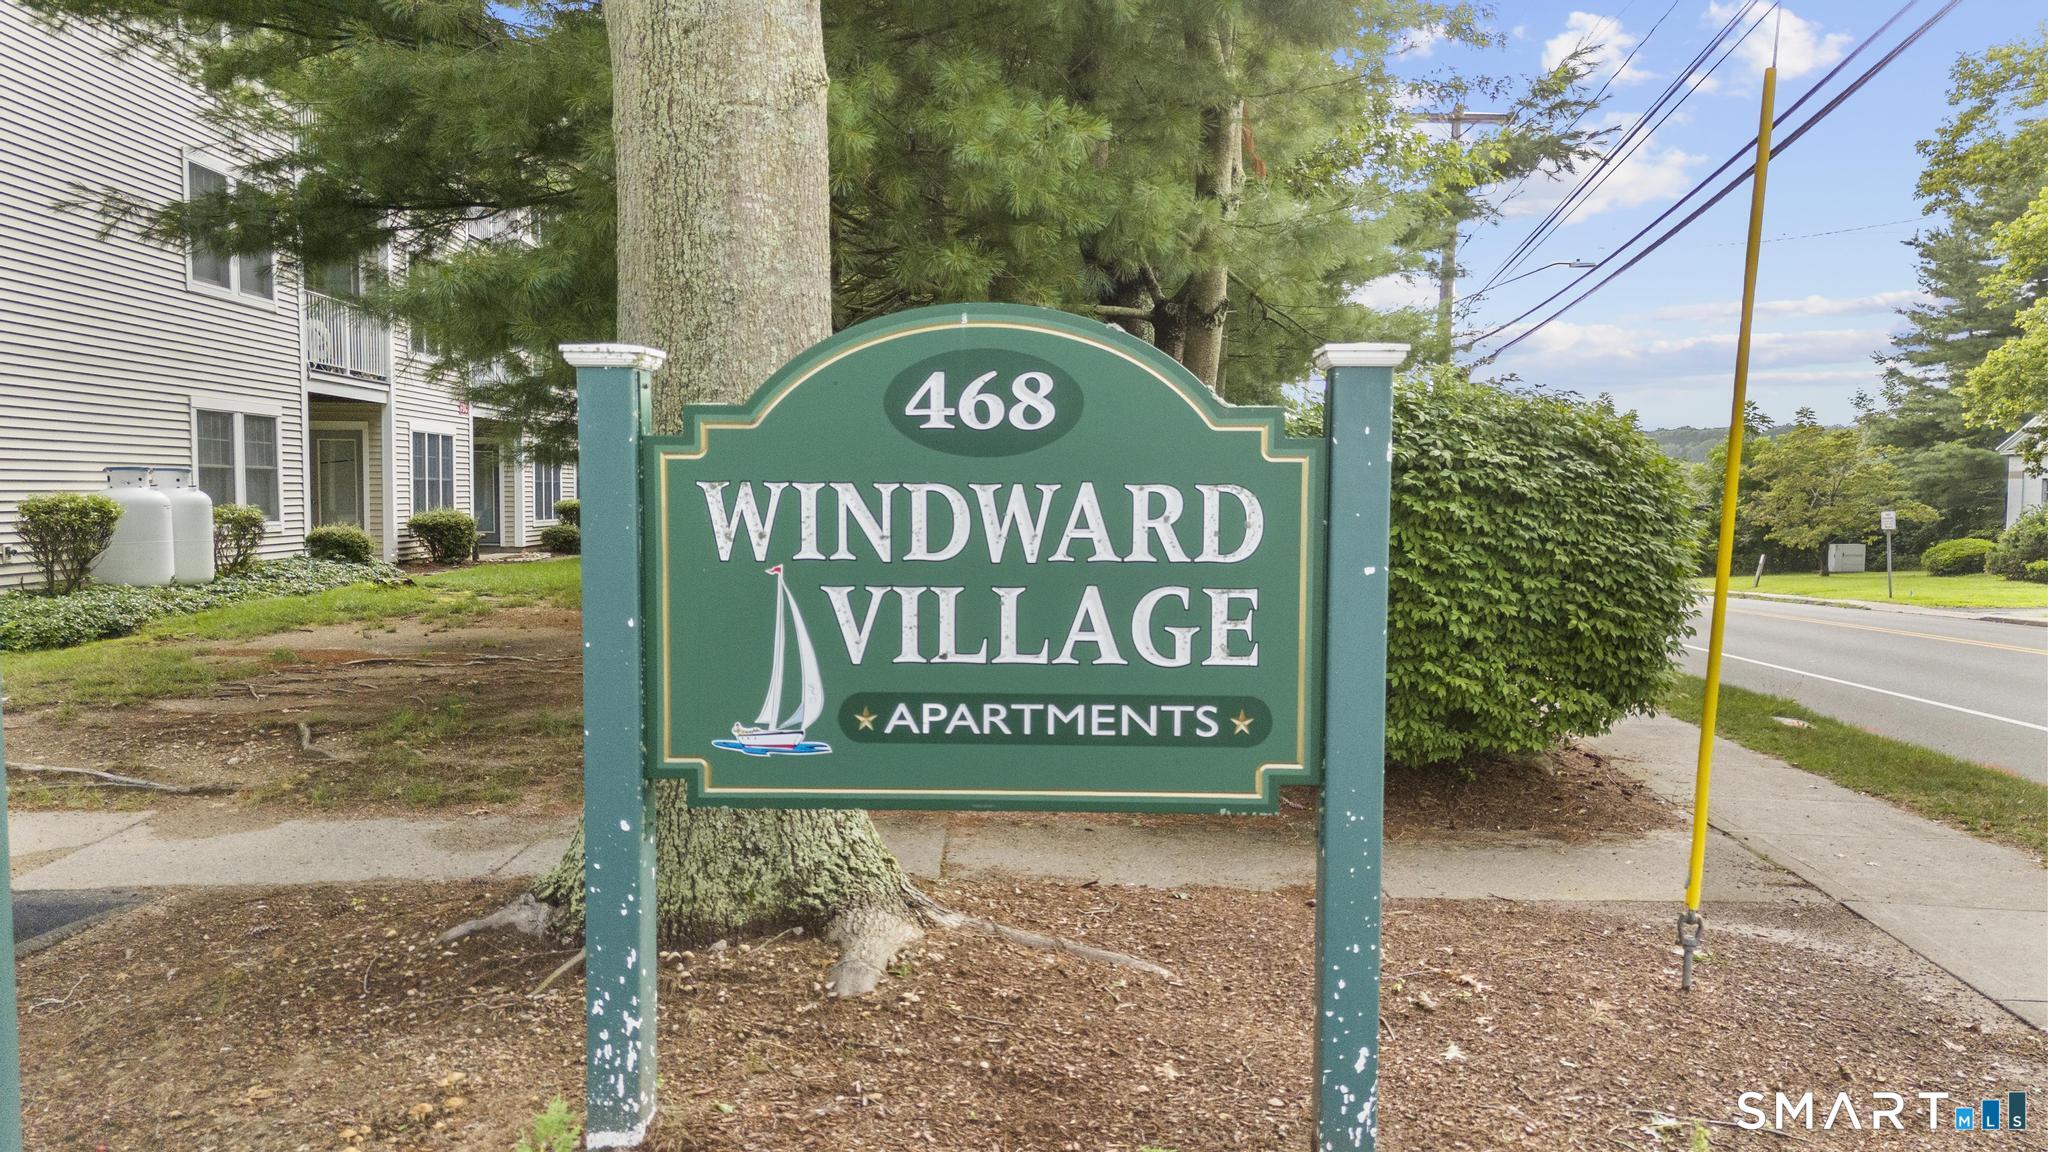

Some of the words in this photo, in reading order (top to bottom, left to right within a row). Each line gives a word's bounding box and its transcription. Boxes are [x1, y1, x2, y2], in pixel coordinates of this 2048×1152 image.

[905, 370, 1056, 430] 468
[696, 481, 1264, 564] WINDWARD
[820, 585, 1260, 667] VILLAGE
[884, 703, 1219, 737] APARTMENTS
